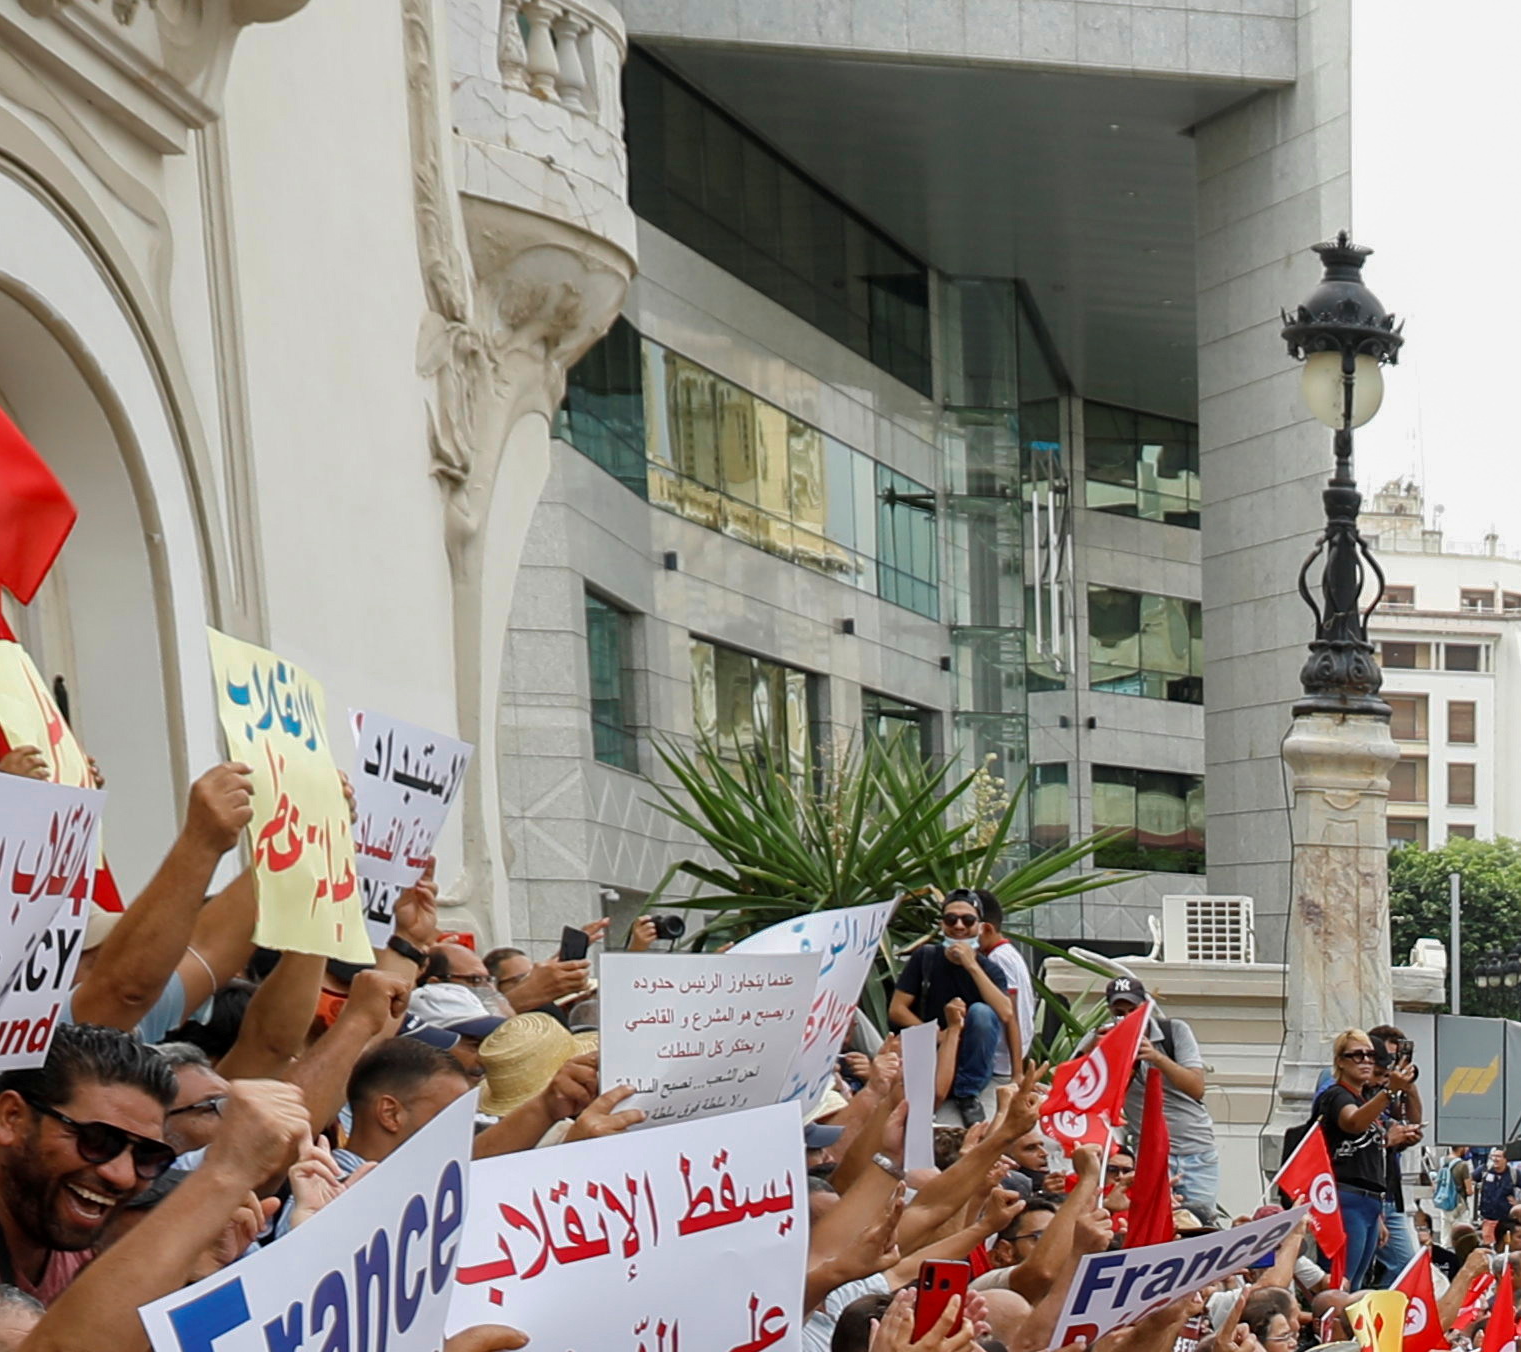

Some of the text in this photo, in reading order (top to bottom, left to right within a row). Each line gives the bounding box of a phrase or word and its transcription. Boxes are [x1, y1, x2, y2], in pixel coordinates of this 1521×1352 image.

[633, 972, 795, 994] عندما يتجاوز الرئيس حدوده
[624, 1007, 675, 1032] القاضي
[692, 1006, 734, 1031] المشرع
[737, 1009, 753, 1026] هو
[755, 1007, 785, 1028] يصبح
[656, 1039, 706, 1060] السلطات
[707, 1038, 725, 1057] كل
[706, 1067, 737, 1088] الشعب
[454, 1148, 795, 1307] يسقط الإنقلاب
[1070, 1221, 1293, 1317] France
